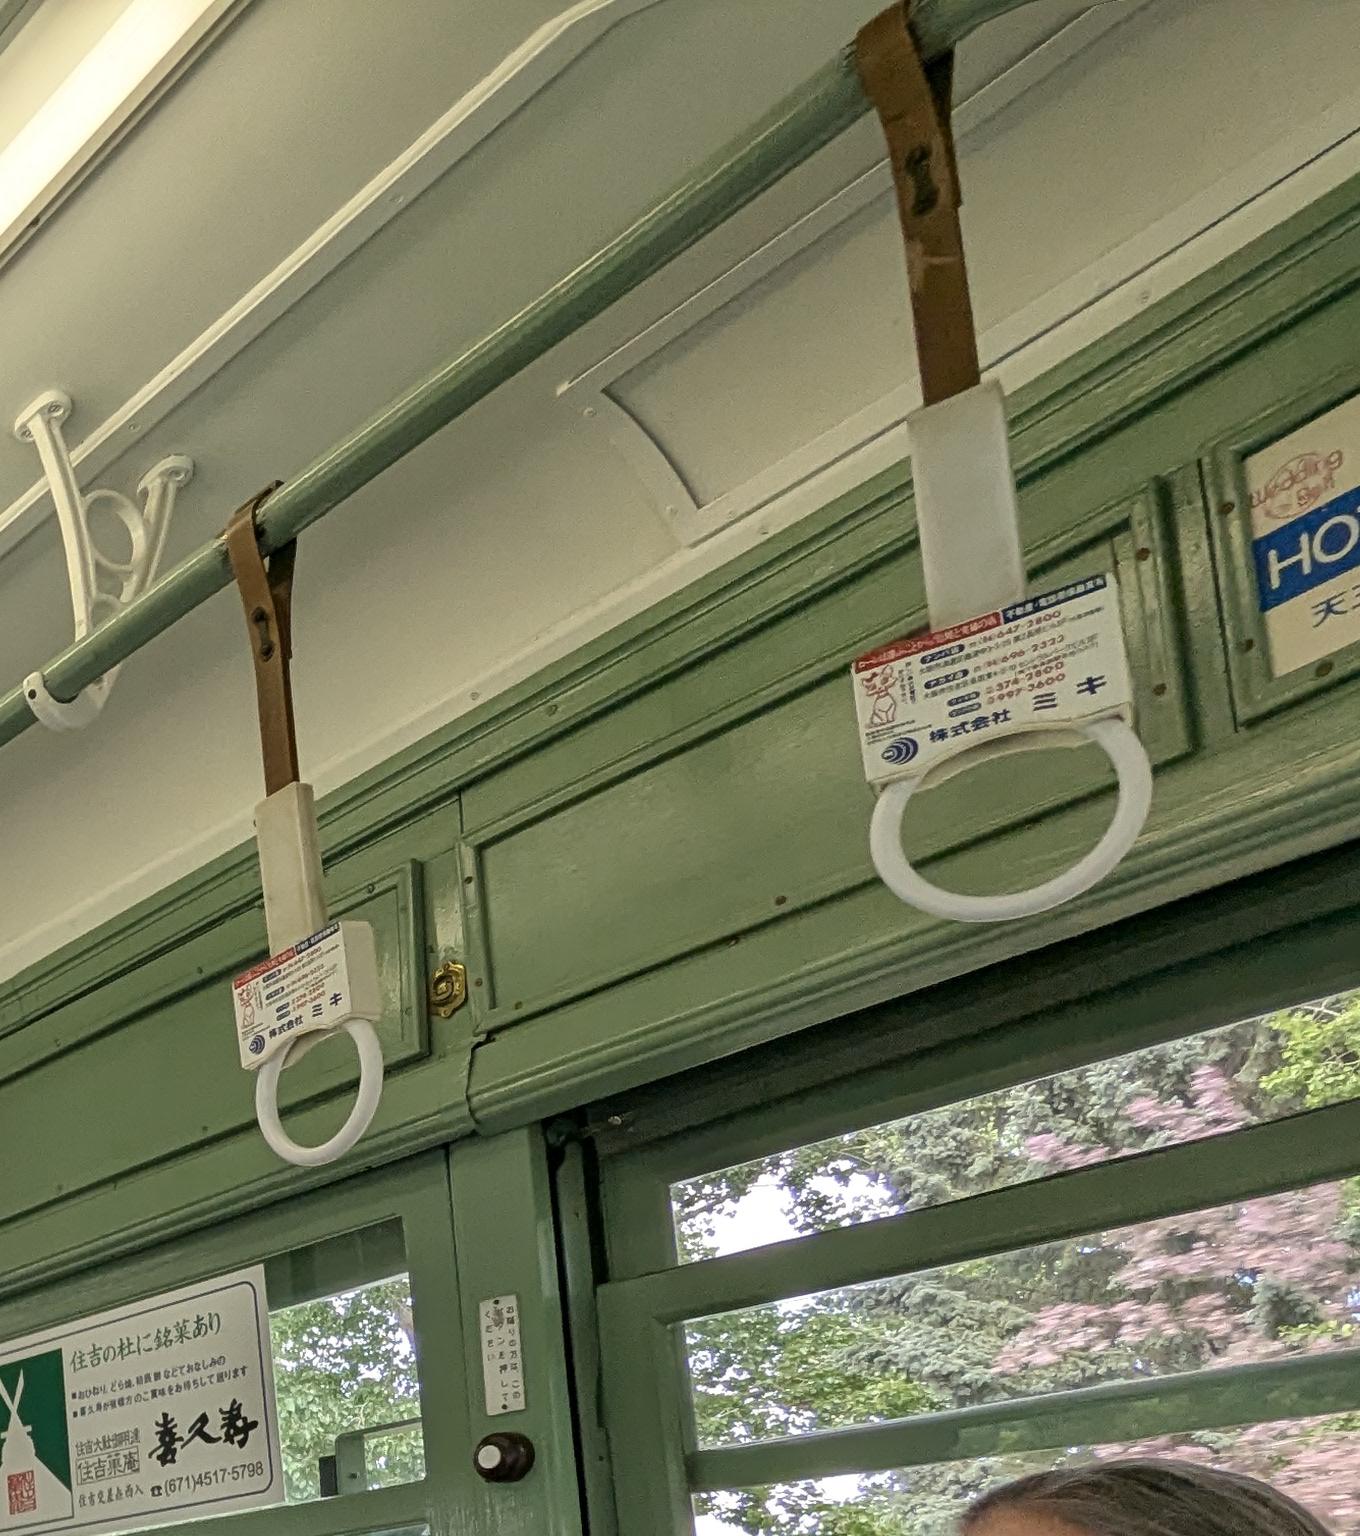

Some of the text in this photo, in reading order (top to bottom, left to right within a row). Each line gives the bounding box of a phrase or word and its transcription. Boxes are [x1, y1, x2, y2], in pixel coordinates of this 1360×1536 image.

[1267, 505, 1360, 590] HO
[929, 708, 1012, 743] 株式会社
